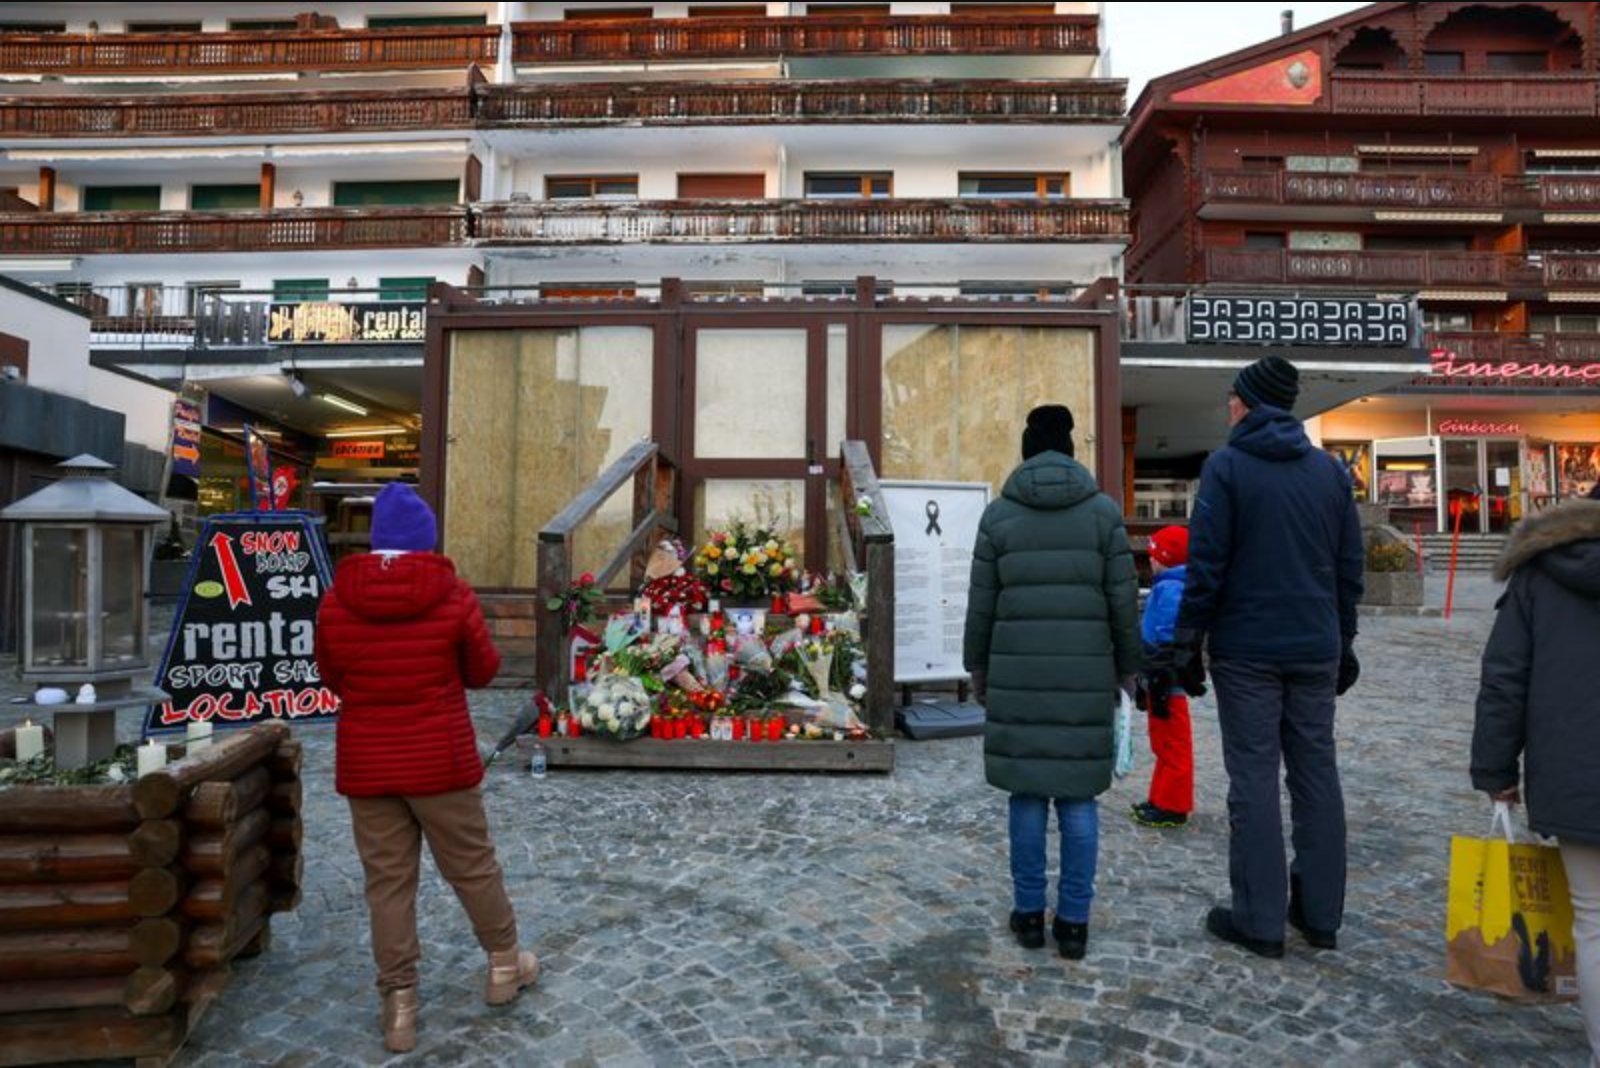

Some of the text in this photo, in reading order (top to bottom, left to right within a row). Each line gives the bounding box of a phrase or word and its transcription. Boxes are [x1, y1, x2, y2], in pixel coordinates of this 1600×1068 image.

[241, 531, 299, 553] SNOW
[256, 552, 310, 573] BOARD
[266, 575, 318, 598] SKI
[183, 611, 315, 661] renta
[169, 662, 262, 689] SPORT
[162, 688, 341, 723] LOCATION
